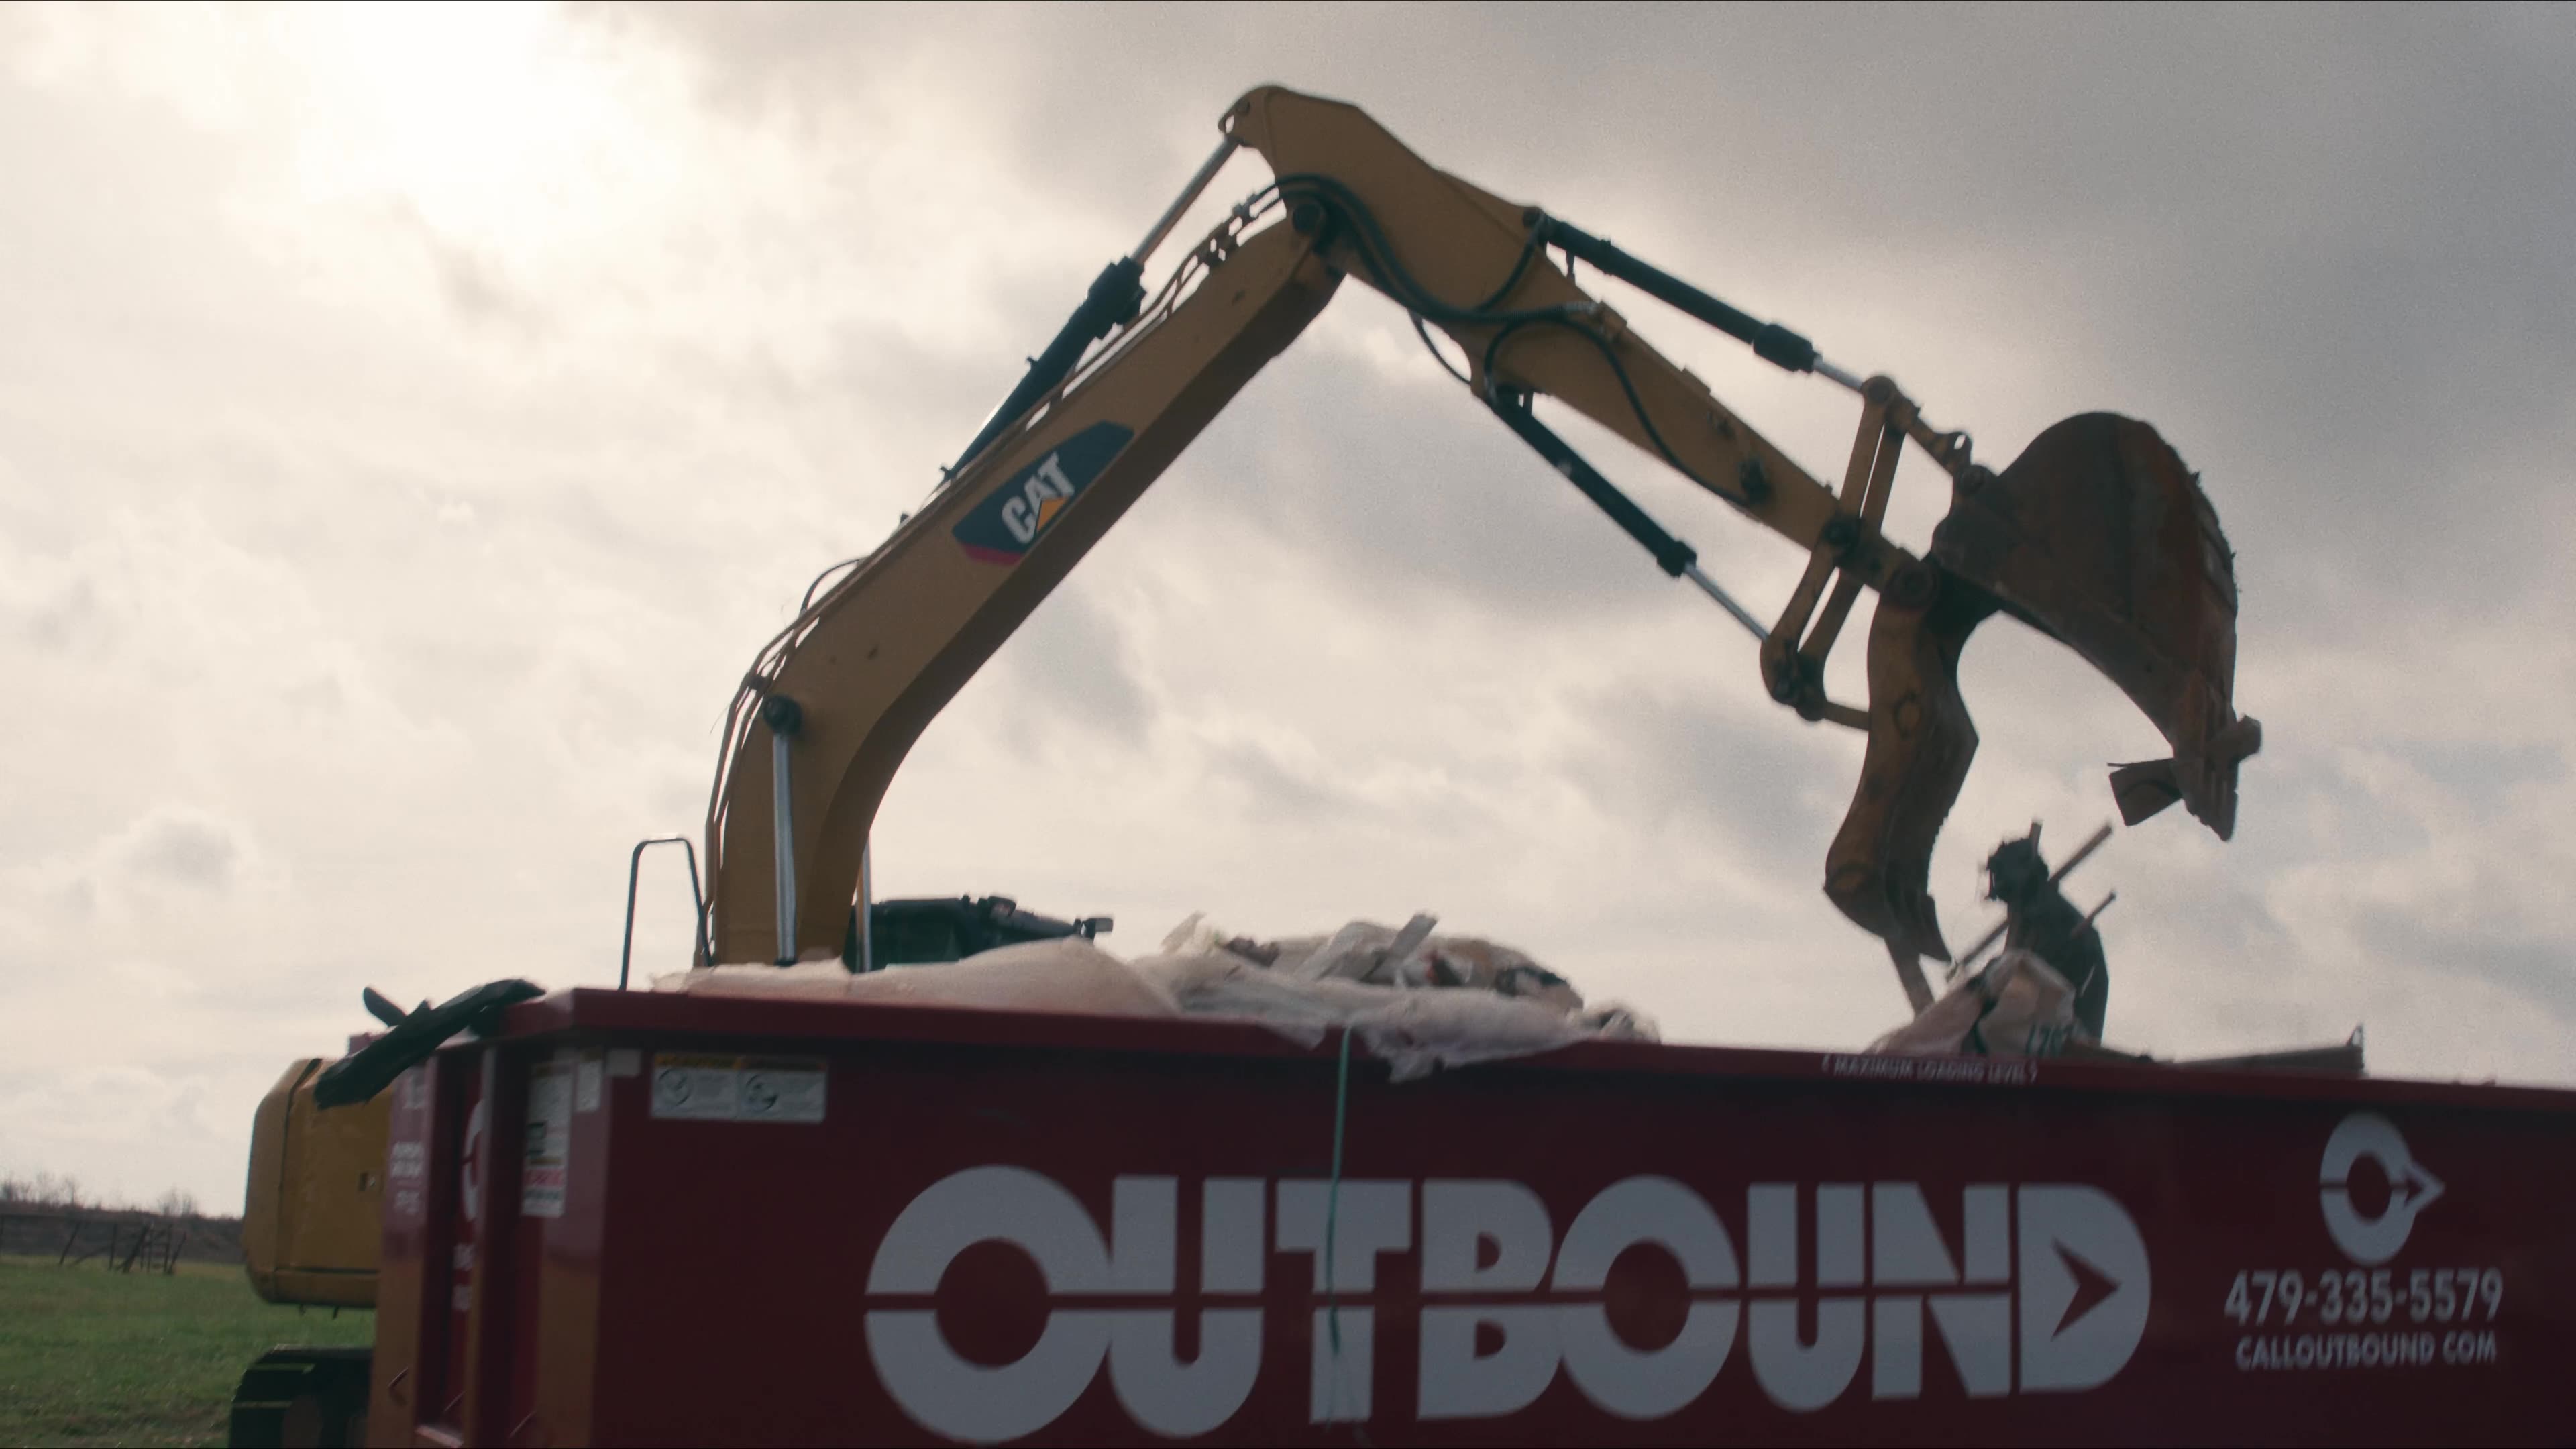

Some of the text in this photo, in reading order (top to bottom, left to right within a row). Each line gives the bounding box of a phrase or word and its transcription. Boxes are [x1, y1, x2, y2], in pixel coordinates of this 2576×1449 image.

[1002, 451, 1075, 544] CAT
[1834, 1055, 2025, 1084] MAXIMUM LOADING LEVEL
[865, 1165, 2151, 1444] OUTBOUND
[2224, 1267, 2504, 1326] 479-335-5579
